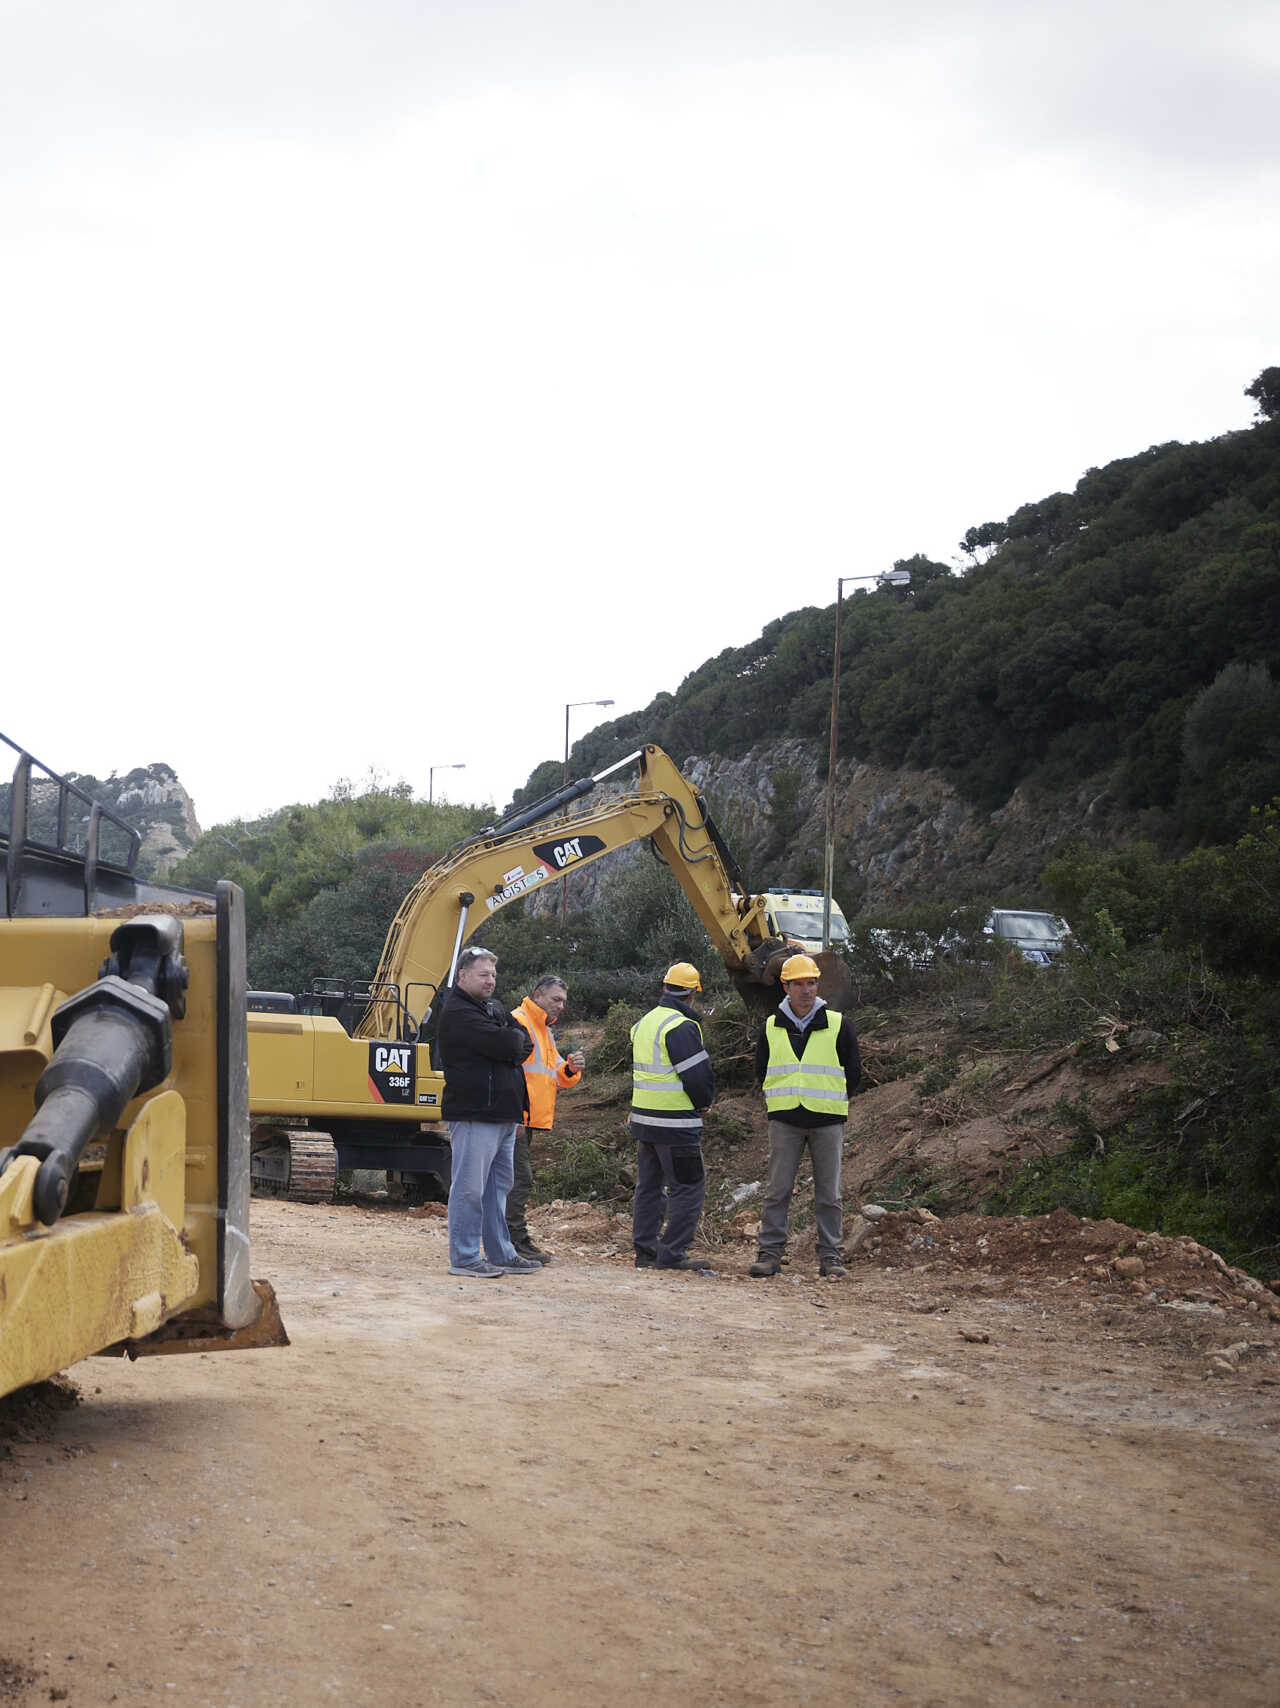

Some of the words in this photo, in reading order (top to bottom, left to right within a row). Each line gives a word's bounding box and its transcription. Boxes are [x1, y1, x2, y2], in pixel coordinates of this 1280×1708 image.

[553, 838, 583, 867] CAT
[375, 1047, 411, 1074] CAT
[388, 1076, 411, 1088] 336F
